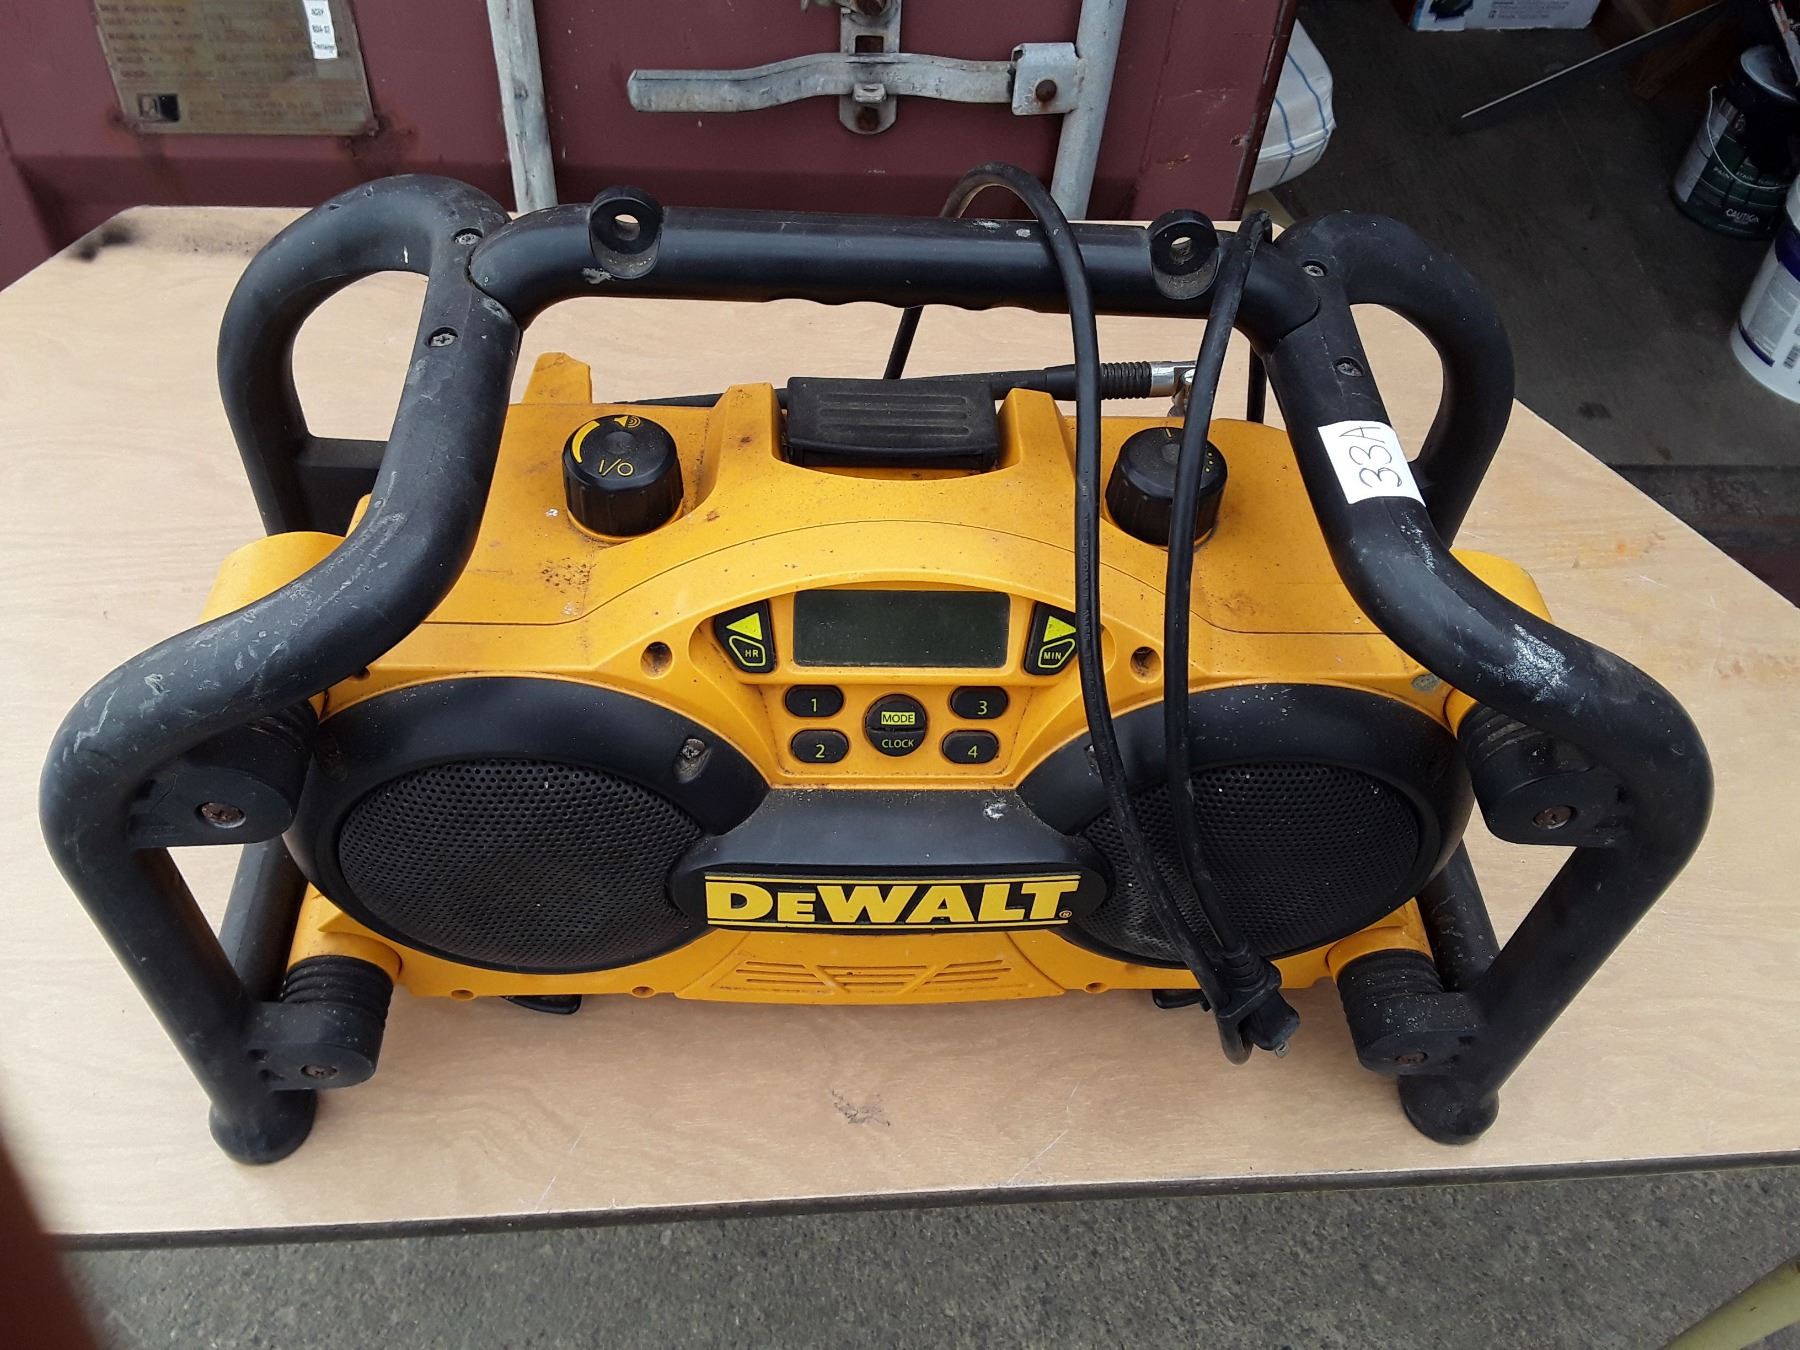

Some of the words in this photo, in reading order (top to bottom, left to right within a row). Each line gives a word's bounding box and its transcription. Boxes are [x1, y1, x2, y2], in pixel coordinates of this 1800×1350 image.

[744, 648, 759, 659] HR
[1043, 651, 1062, 660] MIN
[810, 698, 817, 712] 1
[977, 700, 988, 714] 3
[881, 712, 915, 725] MODE
[881, 737, 915, 749] CLOCK
[815, 744, 825, 758] 2
[967, 745, 978, 759] 4
